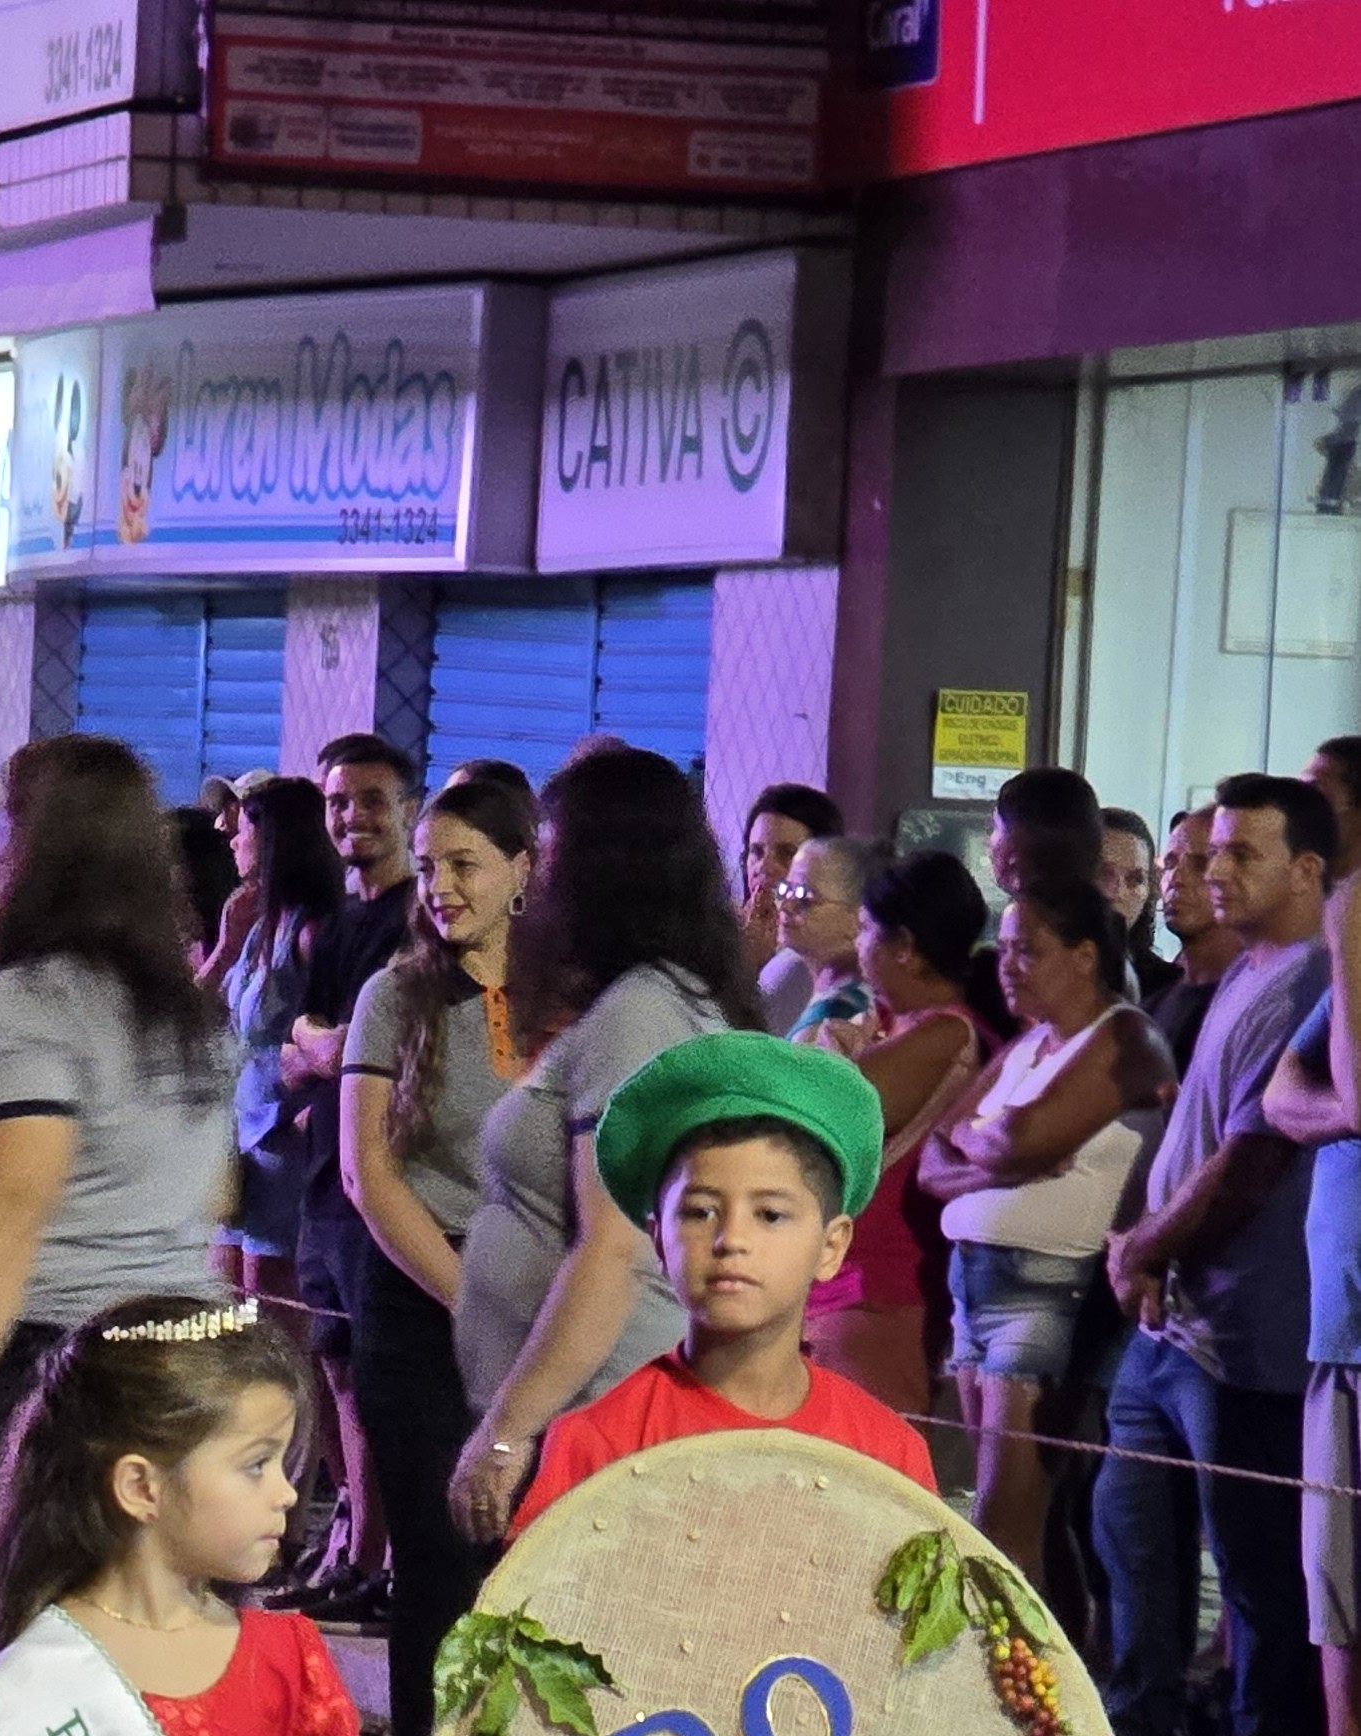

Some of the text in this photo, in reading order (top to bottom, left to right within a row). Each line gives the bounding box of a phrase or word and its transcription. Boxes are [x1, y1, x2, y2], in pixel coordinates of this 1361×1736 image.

[43, 20, 124, 104] 3341-1324
[288, 330, 457, 505] Modas
[557, 344, 704, 493] CATIVA
[337, 507, 439, 545] 3341-1324
[944, 694, 1020, 715] CUIDADO
